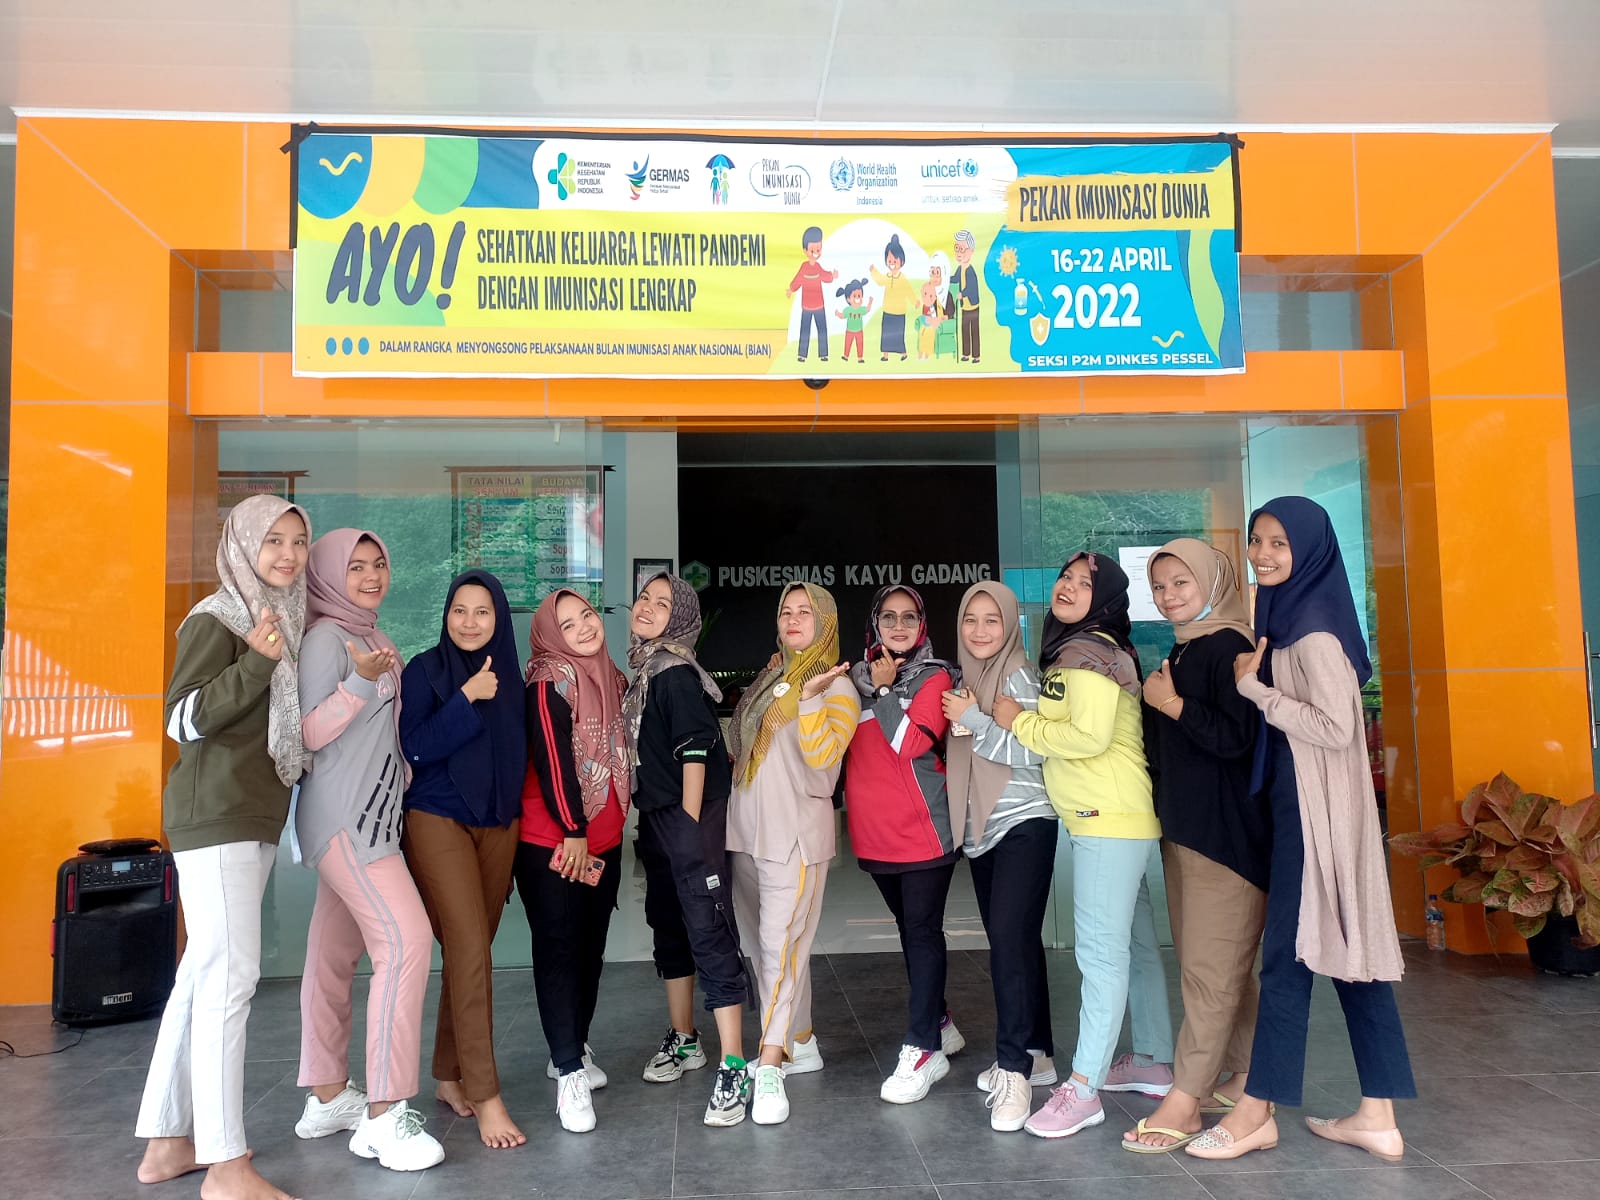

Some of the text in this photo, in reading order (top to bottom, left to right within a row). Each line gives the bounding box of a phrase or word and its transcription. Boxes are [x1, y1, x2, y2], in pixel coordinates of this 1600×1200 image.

[649, 168, 690, 182] GERMAS
[762, 159, 780, 172] PEKAN
[857, 163, 897, 176] World Health
[921, 159, 962, 178] unicef
[762, 174, 802, 189] IMUNISASI
[857, 176, 898, 190] Organization
[784, 192, 801, 206] DUNIA
[1019, 183, 1210, 222] PEKAN IMUNISASI DUNIA
[477, 229, 766, 267] SEHATKAN KELUARGA LEWATI PANDEMI
[326, 221, 466, 310] AYO!
[1051, 247, 1172, 273] 16-22 APRIL
[478, 275, 697, 312] DENGAN IMUNISASI LENGKAP
[1051, 282, 1142, 329] 2022
[380, 340, 772, 359] DALAM RANGKA MENYONGSONG PELAKSANAAN BULAN IMUNISASI ANAK NASIONAL (BIAN)
[1028, 352, 1213, 367] SEKSI P2M DINKES PESSEL
[468, 477, 525, 486] TATA NILAI
[718, 563, 992, 587] PUSKESMAS KAYU GADANG
